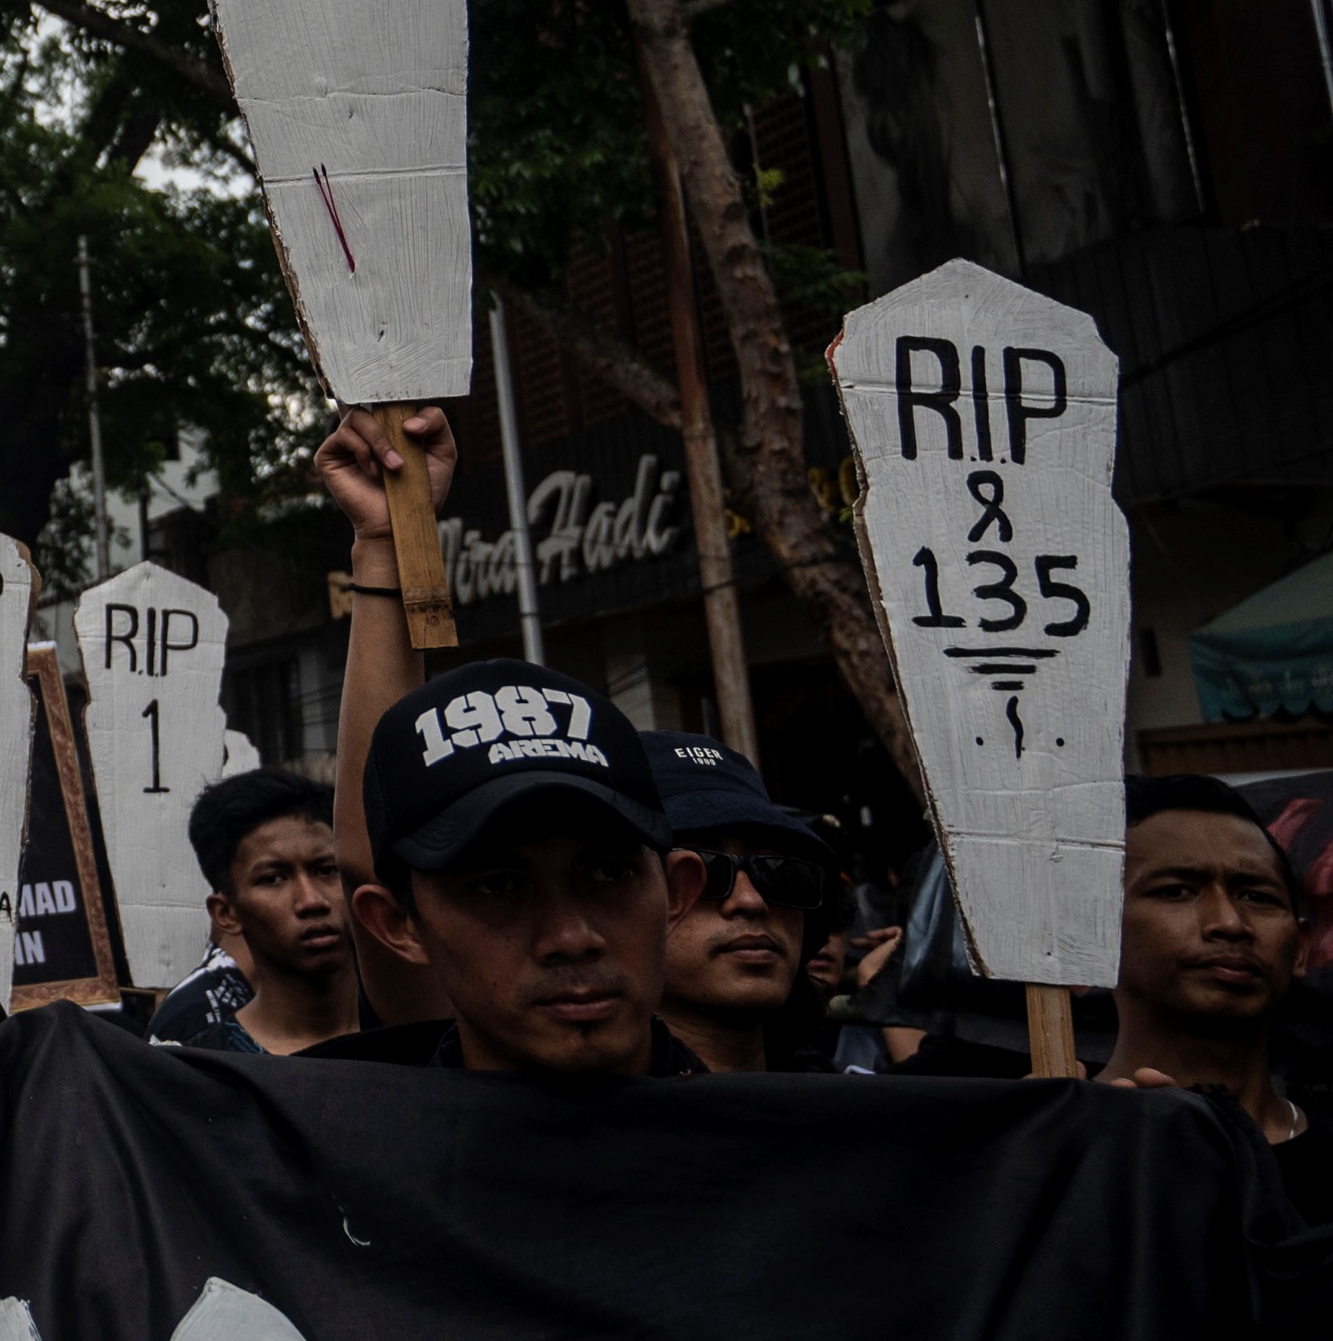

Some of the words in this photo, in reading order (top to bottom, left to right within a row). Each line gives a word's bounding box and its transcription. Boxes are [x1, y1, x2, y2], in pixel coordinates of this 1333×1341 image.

[911, 545, 1091, 638] 135
[141, 698, 170, 794] 1
[415, 685, 593, 768] 1987
[489, 738, 610, 769] AREMA
[674, 746, 724, 761] EIGER
